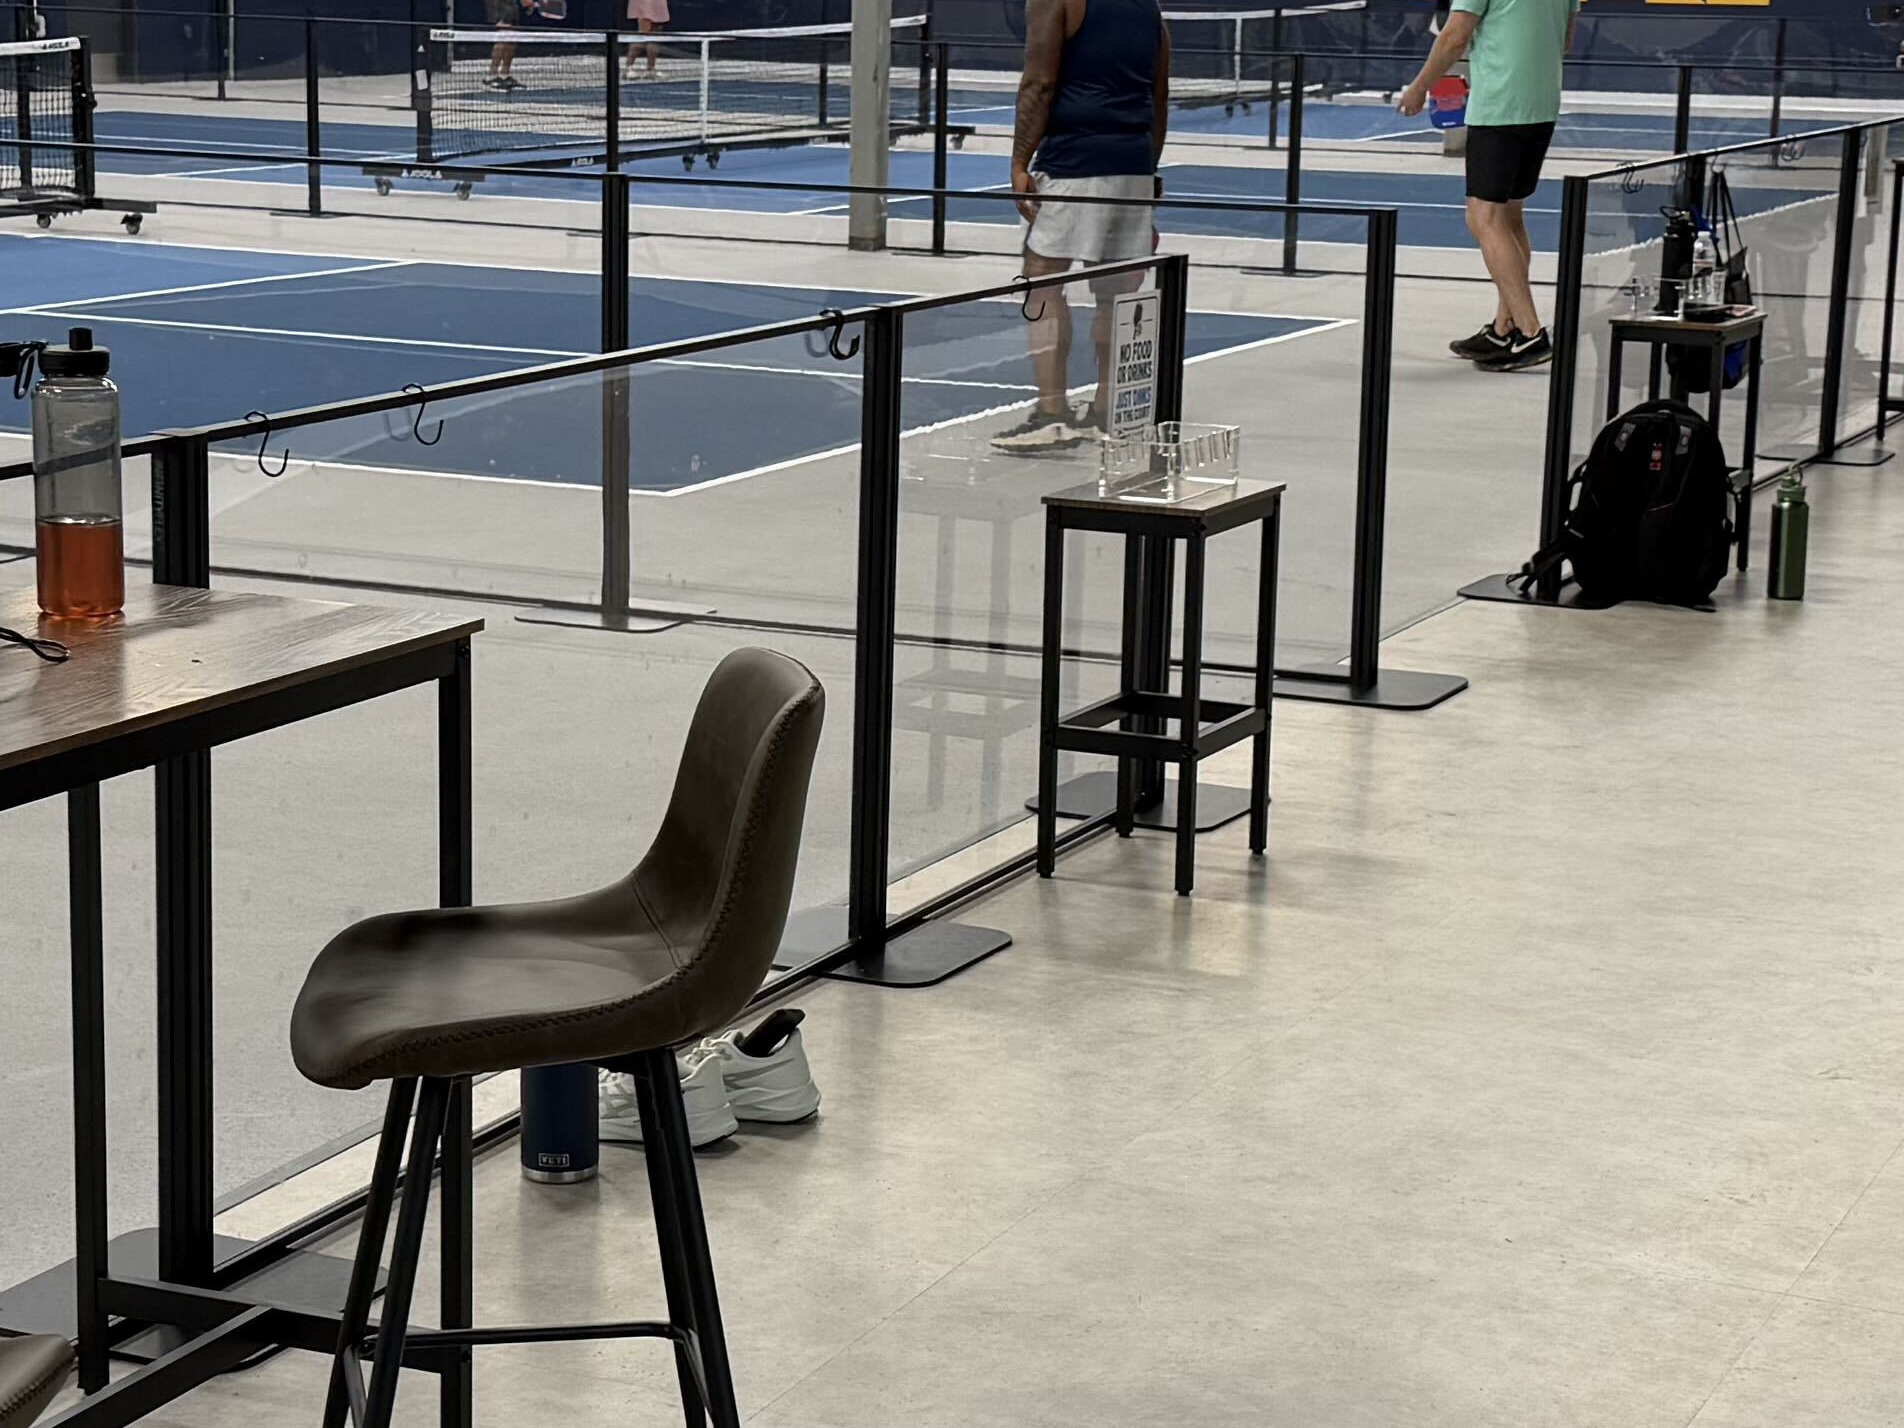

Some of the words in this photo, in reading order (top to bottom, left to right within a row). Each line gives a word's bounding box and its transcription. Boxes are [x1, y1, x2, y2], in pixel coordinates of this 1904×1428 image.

[1120, 342, 1131, 364] NO
[1132, 339, 1153, 362] FOOD
[1117, 365, 1127, 385] OR
[1127, 361, 1153, 384] DRINKS
[1116, 390, 1132, 410] JUST
